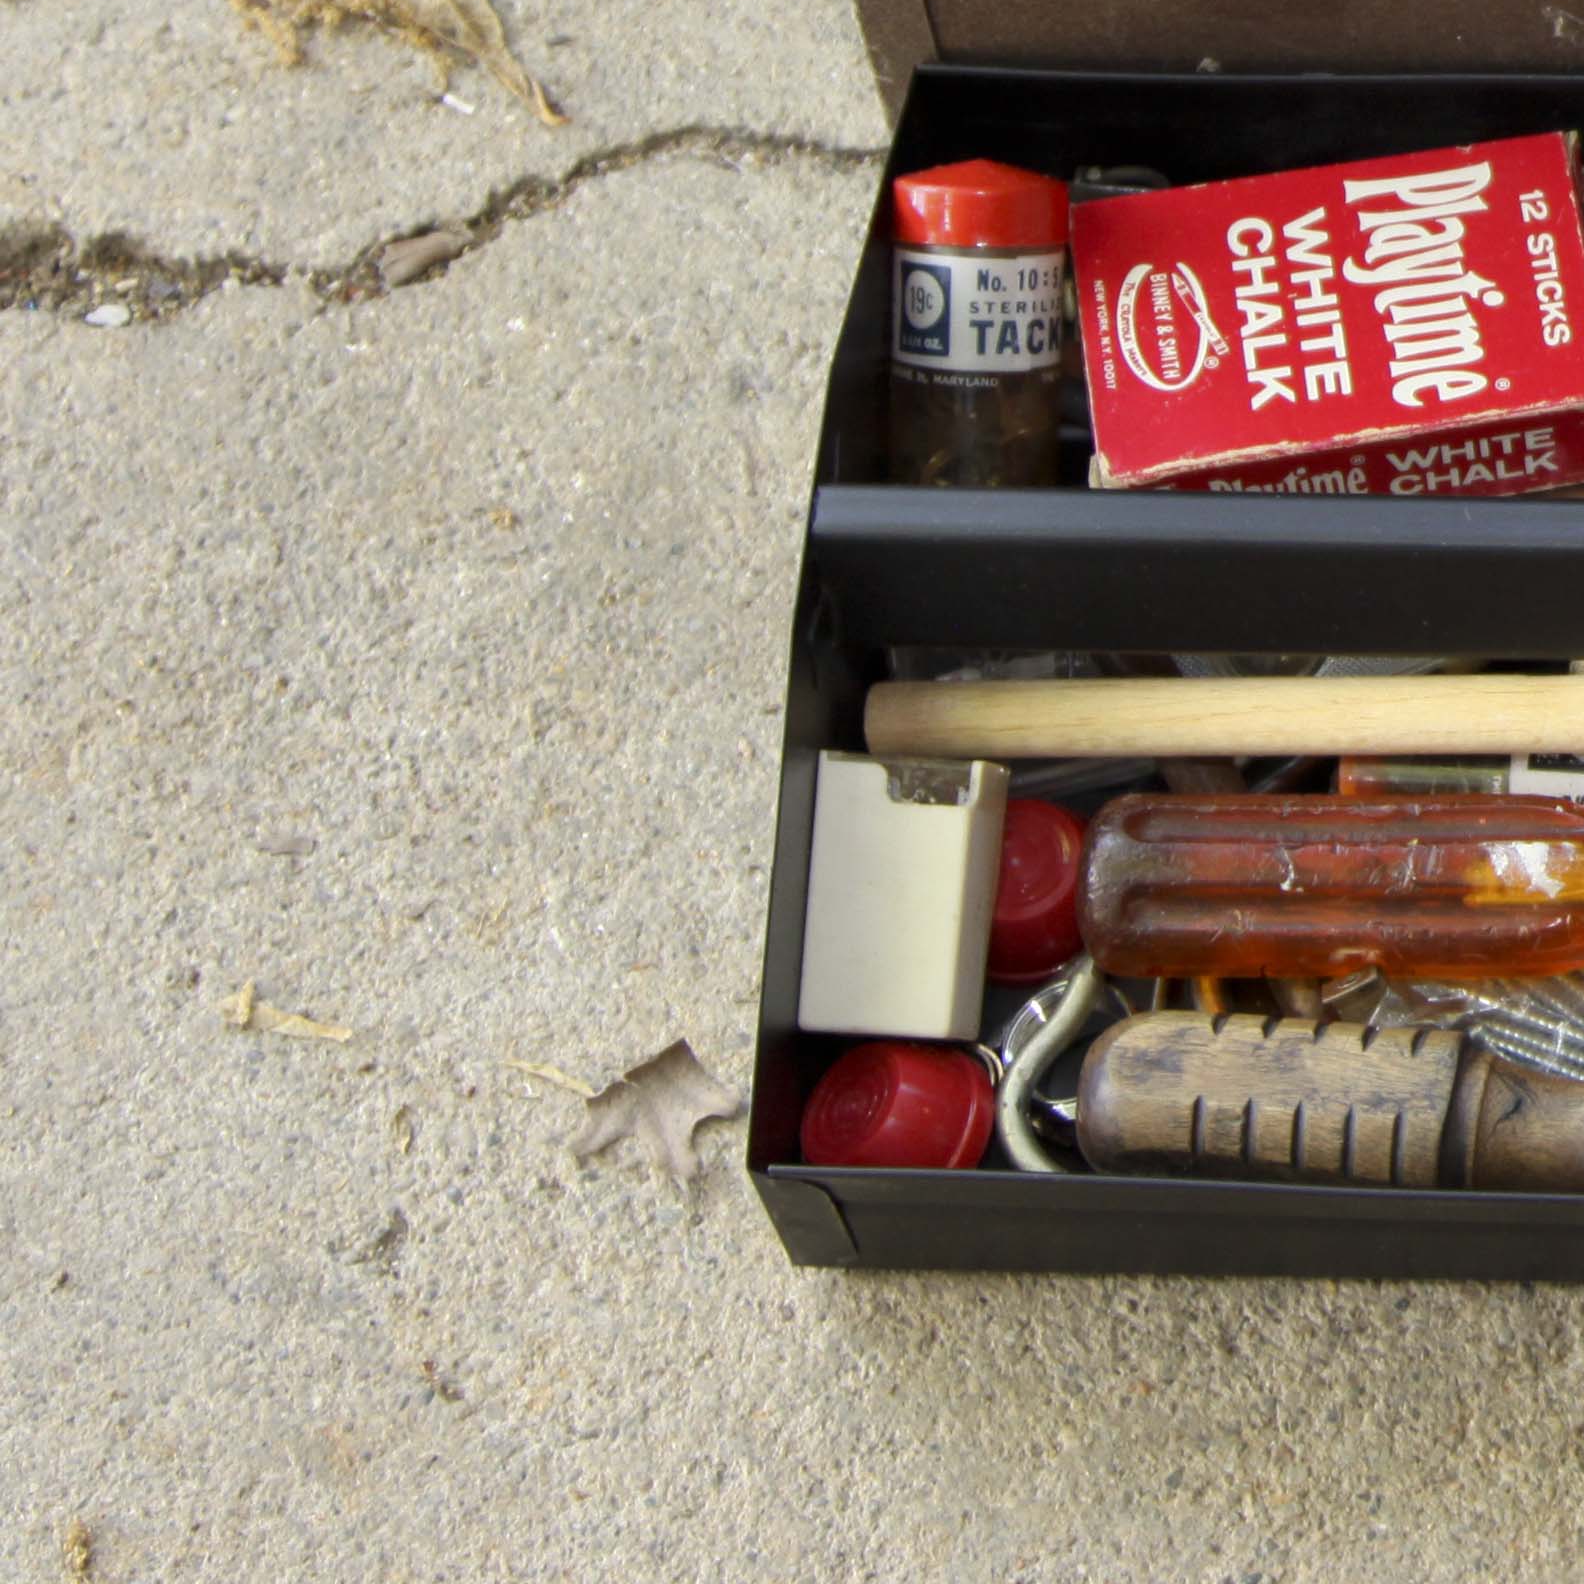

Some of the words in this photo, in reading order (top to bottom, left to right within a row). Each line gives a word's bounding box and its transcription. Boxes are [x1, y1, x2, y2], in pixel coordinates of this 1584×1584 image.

[1518, 189, 1549, 224] 12
[976, 267, 1008, 293] No.
[1149, 272, 1174, 322] BINNEY
[1525, 232, 1574, 347] STICKS
[1226, 216, 1297, 412] CHALK
[1282, 206, 1354, 402] WHITE
[1093, 279, 1106, 304] NEW
[1103, 357, 1117, 391] 10017
[1156, 324, 1172, 337] &
[932, 375, 999, 388] MARYLAND
[1157, 337, 1182, 380] SMITH
[1386, 425, 1556, 472] WHITE
[1389, 450, 1559, 495] CHALK
